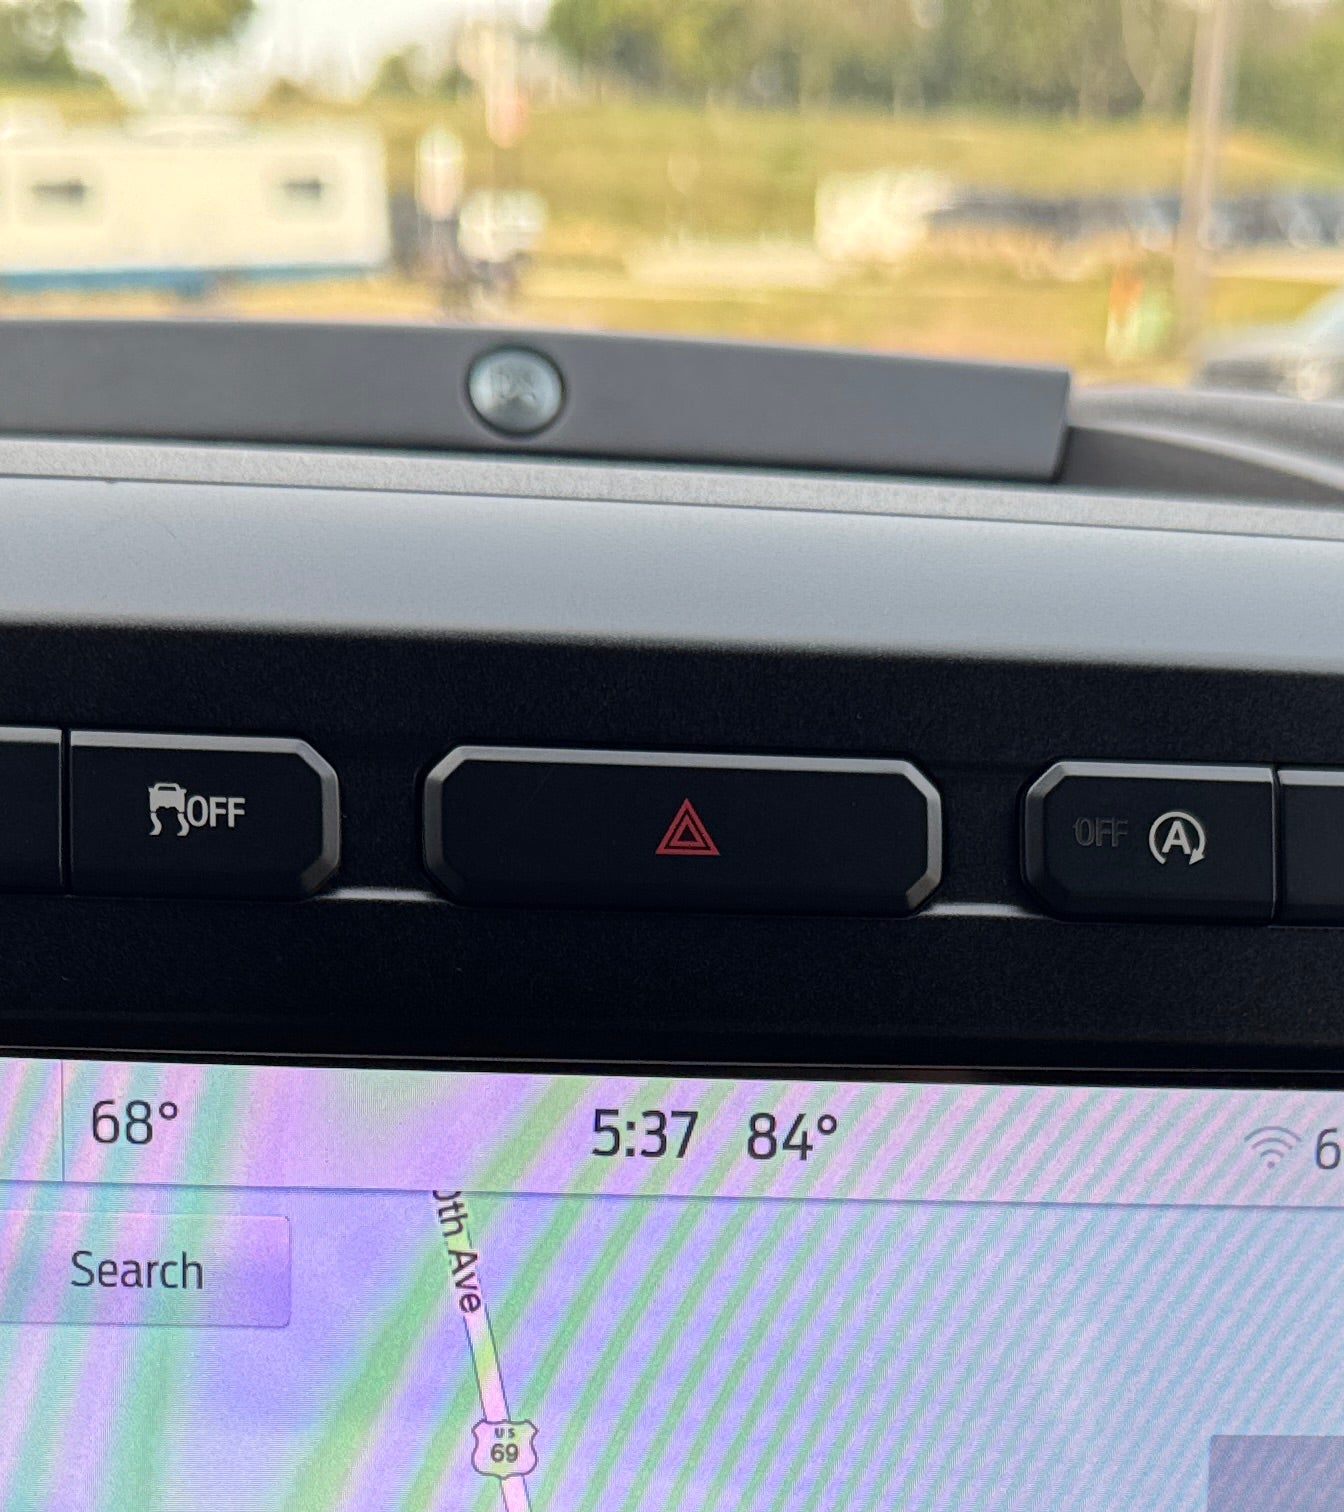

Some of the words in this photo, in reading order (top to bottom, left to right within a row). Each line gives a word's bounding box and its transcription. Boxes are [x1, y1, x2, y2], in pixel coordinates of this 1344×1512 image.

[186, 798, 246, 827] OFF
[1075, 816, 1128, 848] OFF
[90, 1098, 180, 1146] 68°
[591, 1108, 699, 1159] 5:37
[746, 1112, 839, 1162] 84°
[70, 1249, 205, 1291] Search
[448, 1250, 481, 1313] Ave
[494, 1428, 515, 1440] US
[489, 1444, 519, 1464] 69
